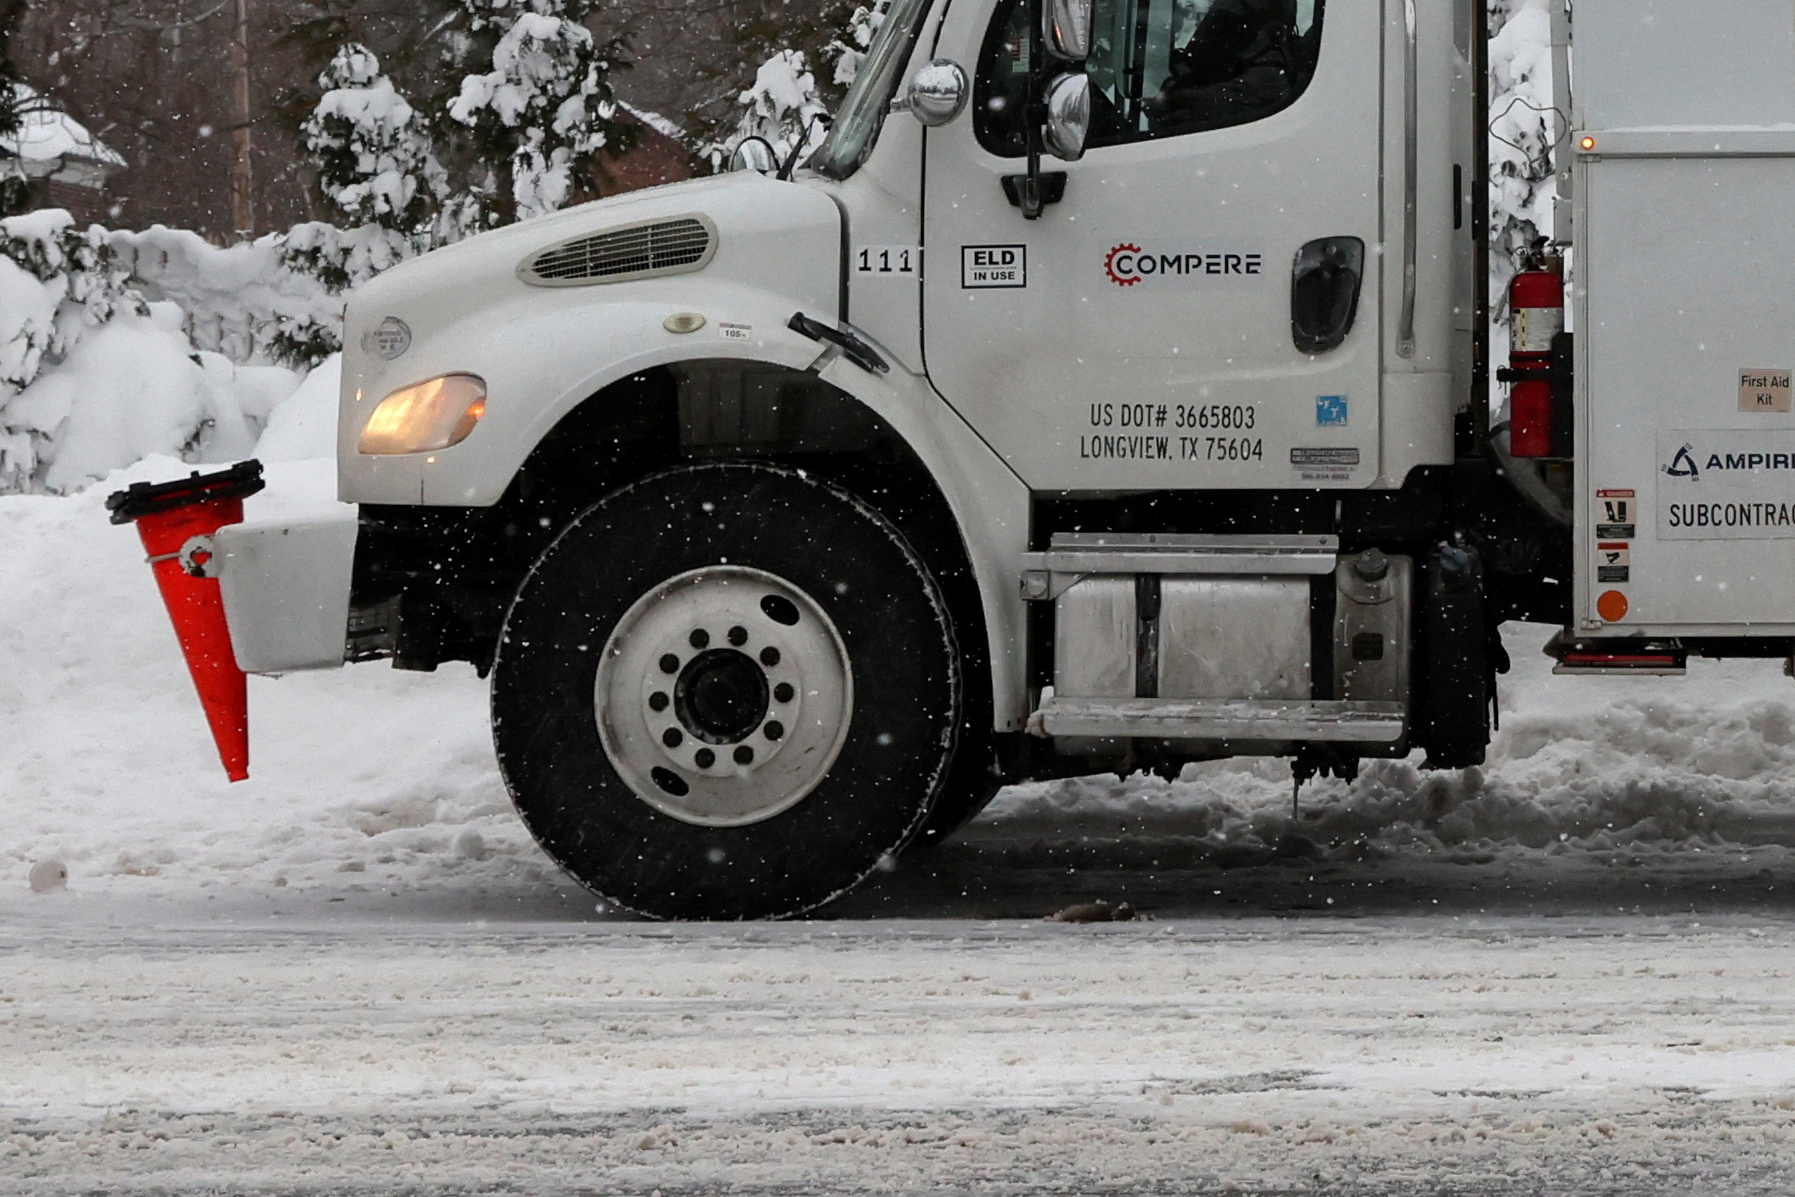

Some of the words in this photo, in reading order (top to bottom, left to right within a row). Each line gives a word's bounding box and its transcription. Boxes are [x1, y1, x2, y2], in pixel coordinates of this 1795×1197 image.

[858, 248, 913, 273] 111
[974, 250, 1015, 266] ELD
[1116, 254, 1262, 275] COMPERE
[973, 272, 987, 281] IN
[990, 271, 1015, 281] USE
[1741, 374, 1767, 387] First
[1770, 375, 1789, 388] Aid
[1756, 393, 1773, 405] Kit
[1090, 403, 1114, 427] US
[1120, 404, 1168, 428] DOT#
[1175, 405, 1256, 429] 3665803
[1080, 435, 1173, 462] LONGVIEW,
[1179, 436, 1198, 461] TX
[1205, 437, 1263, 461] 75604
